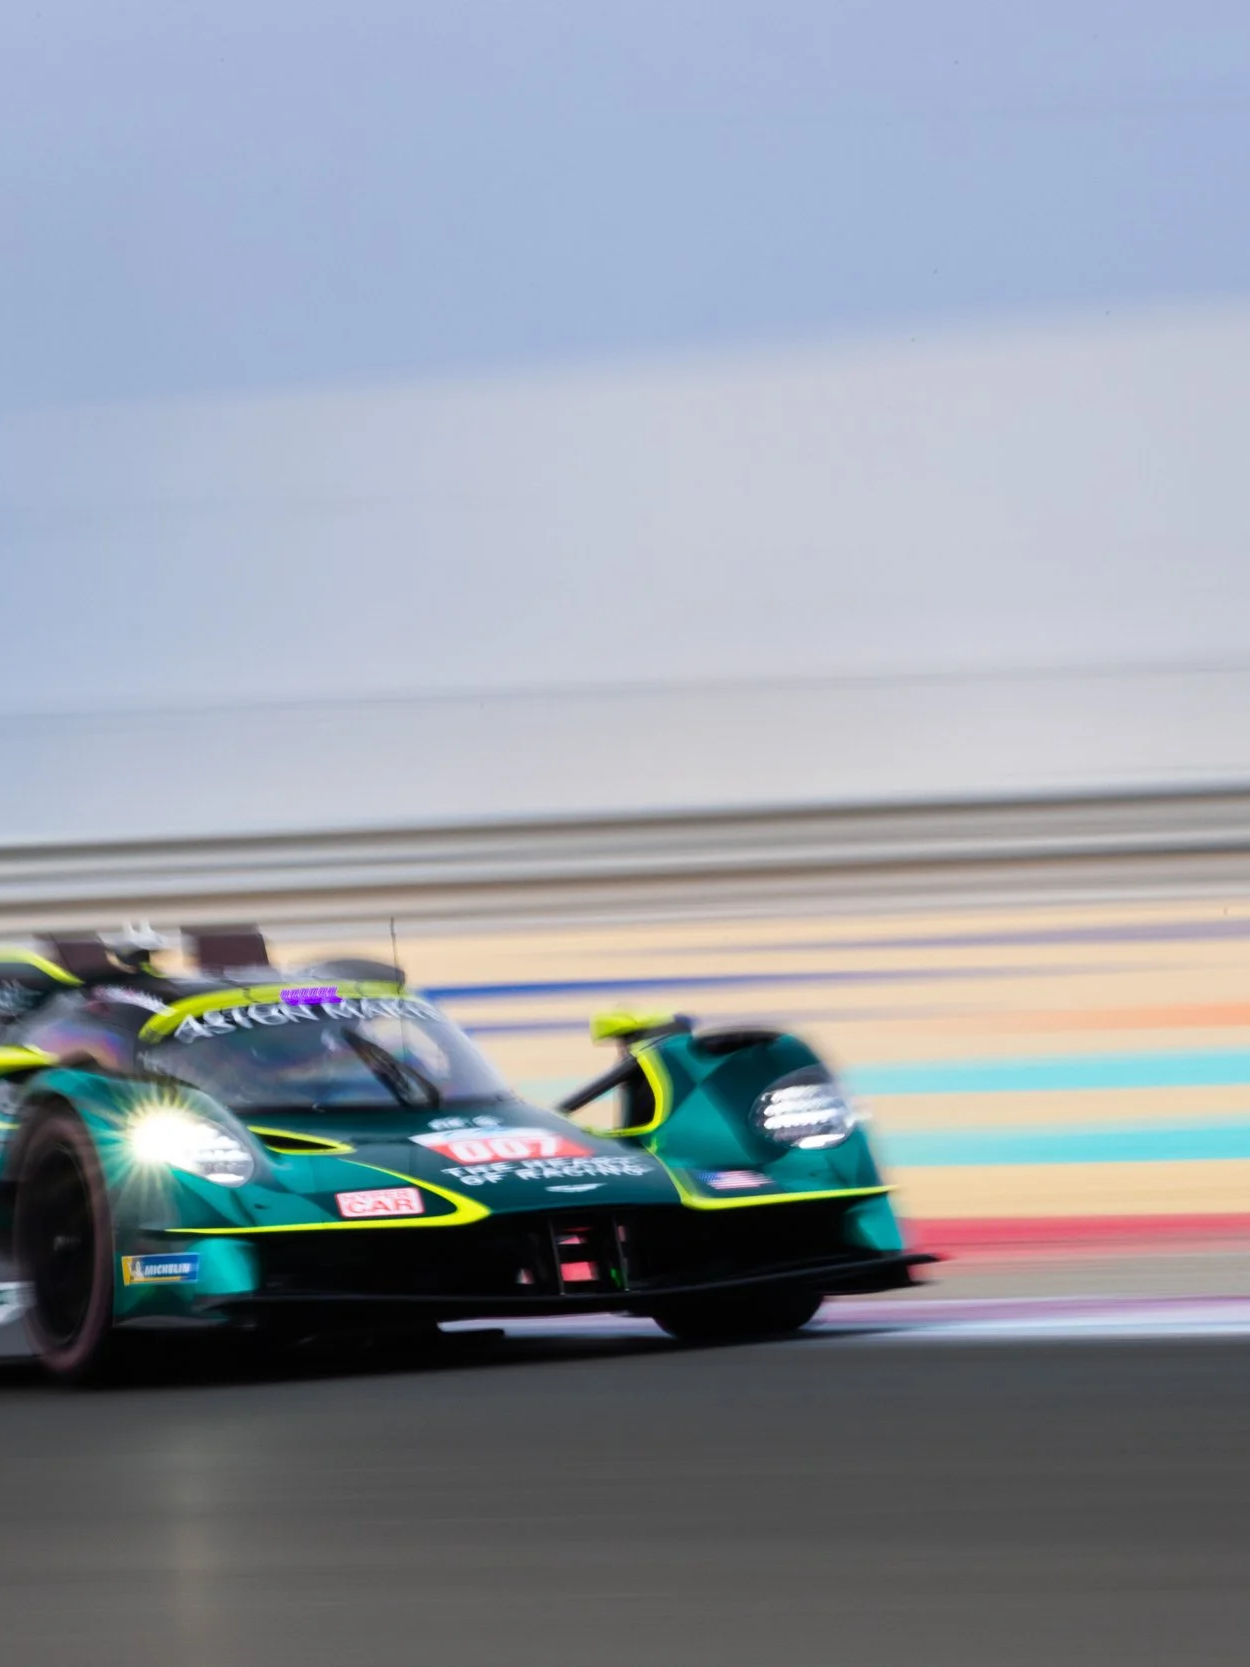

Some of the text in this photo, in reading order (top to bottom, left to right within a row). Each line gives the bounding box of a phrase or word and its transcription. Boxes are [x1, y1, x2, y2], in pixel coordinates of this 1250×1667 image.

[174, 1001, 320, 1043] ASTON
[449, 1137, 559, 1162] 007
[440, 1162, 518, 1178] THE
[459, 1165, 656, 1187] OF RACING
[347, 1199, 415, 1214] CAR
[144, 1263, 191, 1276] MICHELIN
